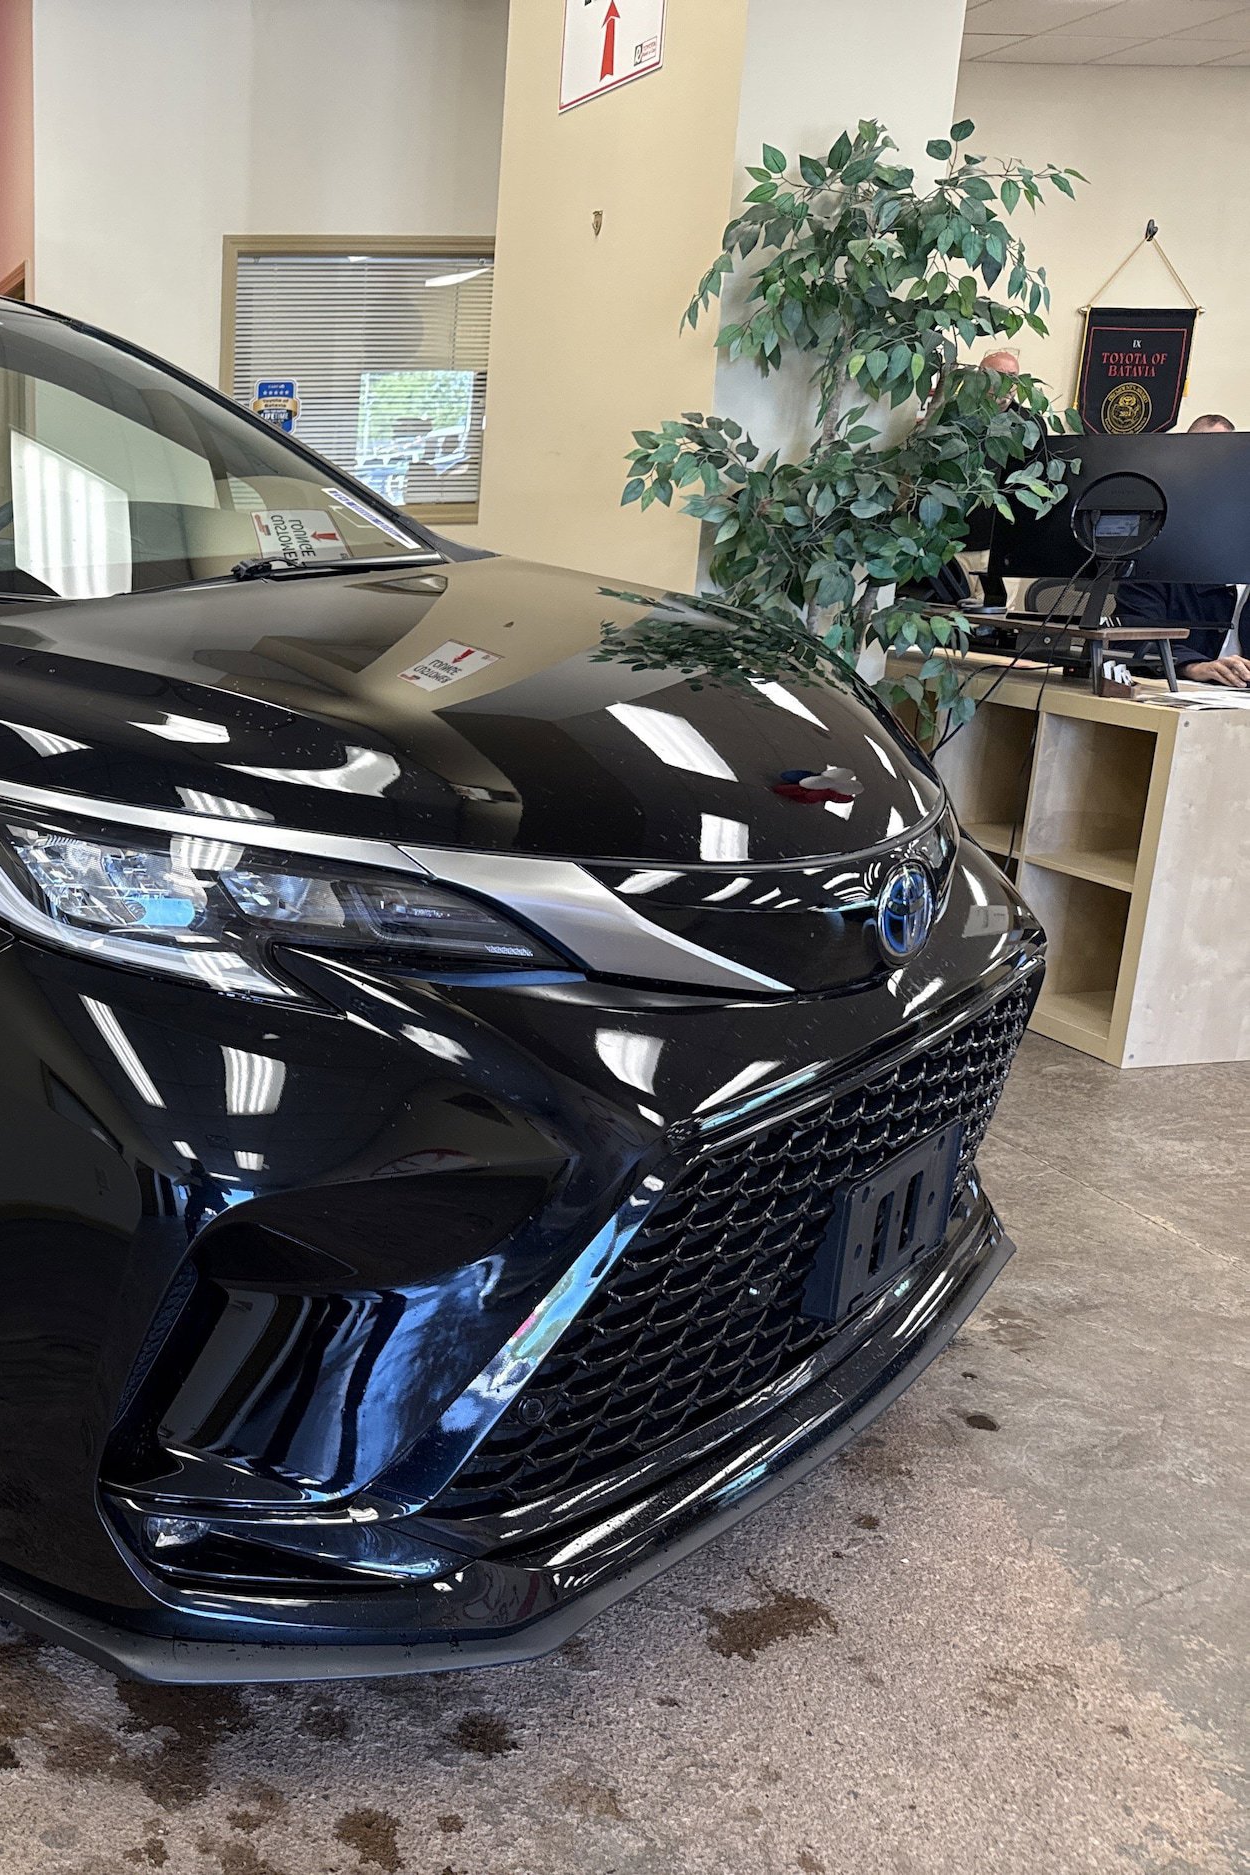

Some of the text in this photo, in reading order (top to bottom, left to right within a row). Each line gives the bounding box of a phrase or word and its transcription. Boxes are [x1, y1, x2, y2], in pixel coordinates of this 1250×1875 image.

[1132, 340, 1142, 348] IX
[1102, 352, 1168, 365] TOYOTA OF
[1108, 365, 1156, 377] BATAVIA
